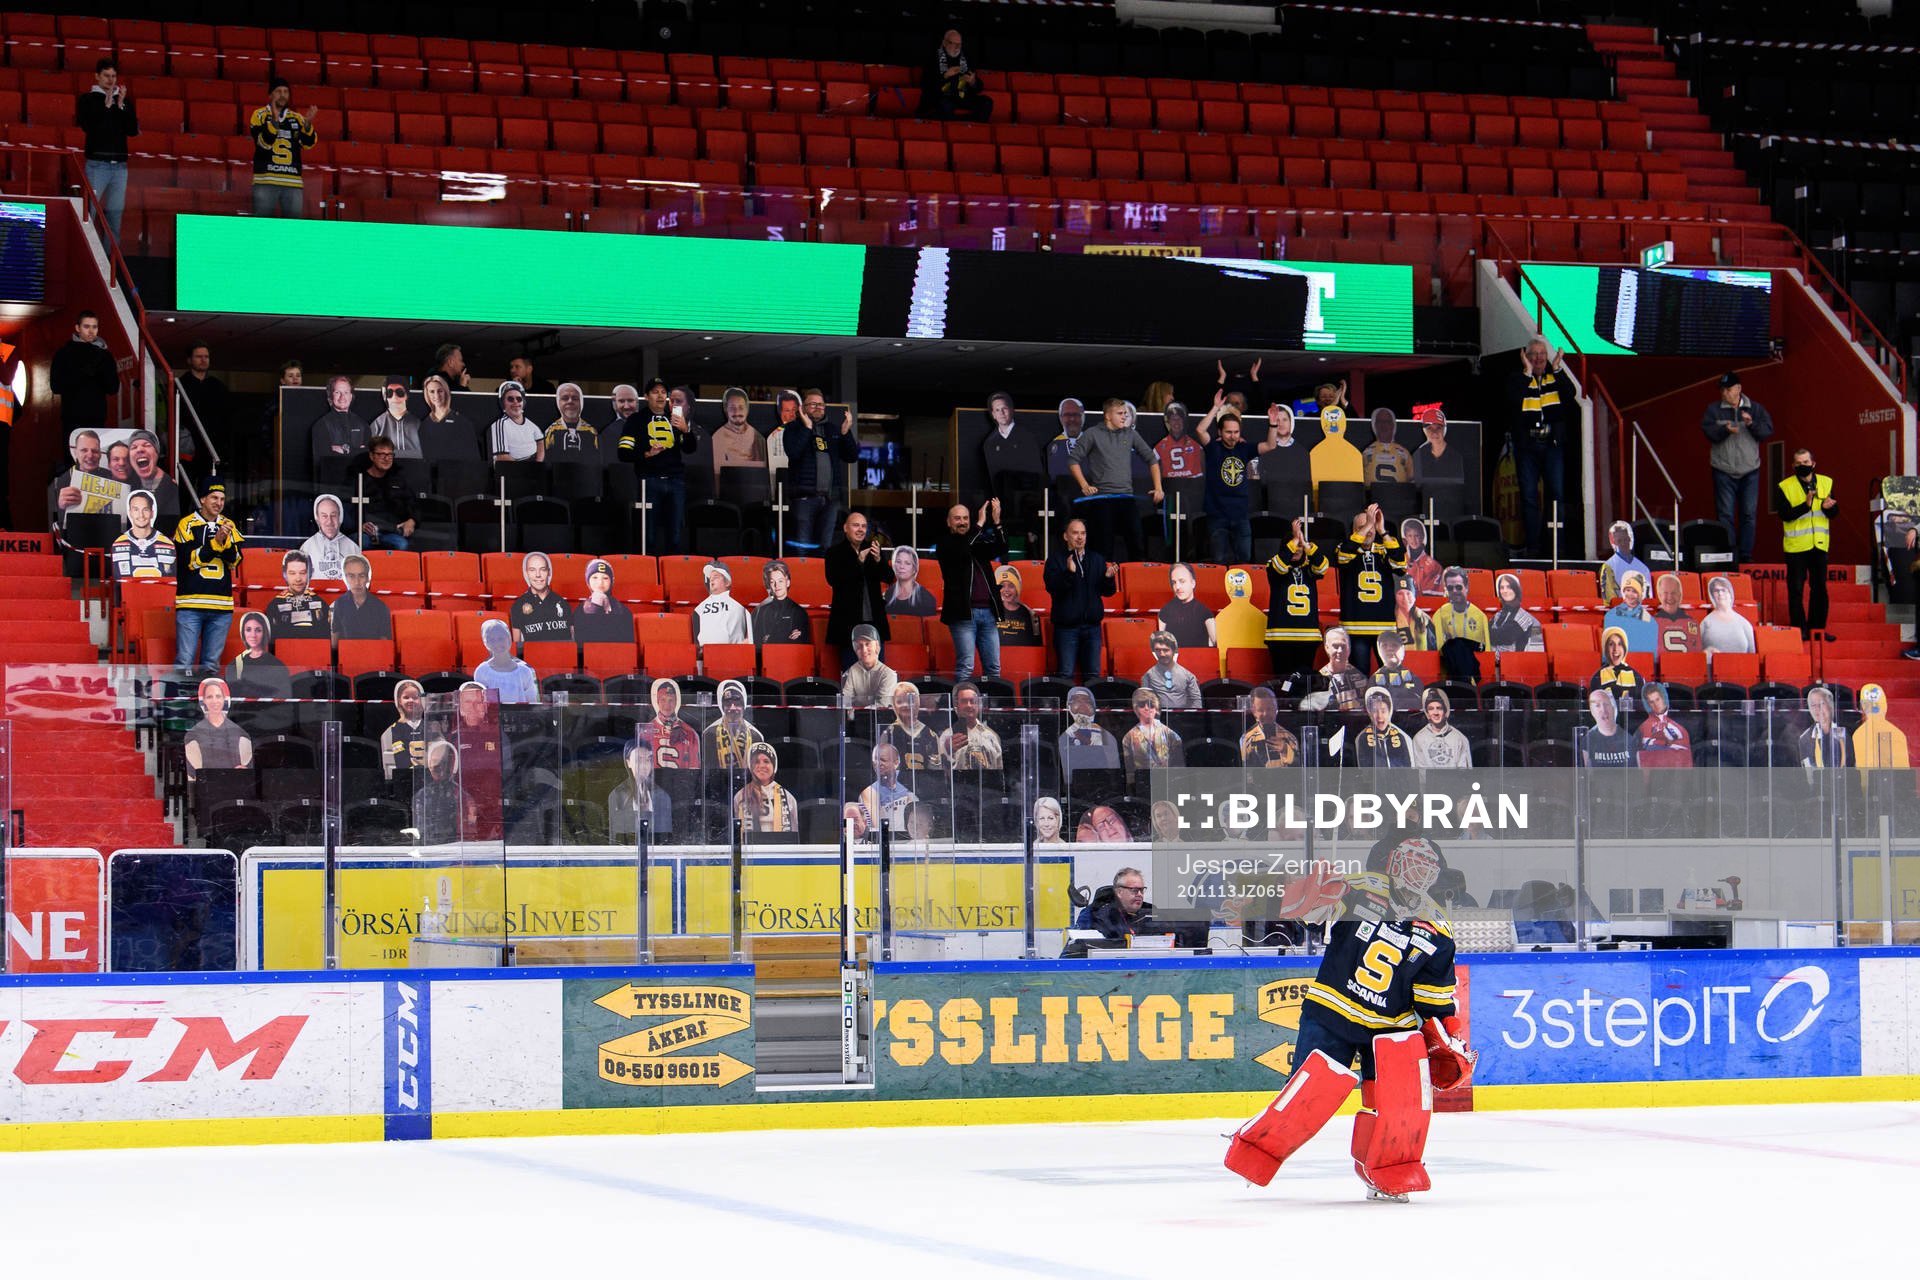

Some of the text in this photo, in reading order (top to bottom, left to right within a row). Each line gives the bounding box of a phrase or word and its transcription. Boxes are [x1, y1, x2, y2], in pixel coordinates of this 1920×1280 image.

[272, 138, 292, 166] S
[267, 164, 298, 173] SCANIA
[1859, 408, 1896, 425] VÄNSTER
[647, 420, 675, 449] S
[1170, 447, 1185, 470] S
[81, 473, 121, 499] HEJA!
[1287, 583, 1311, 616] S
[1358, 570, 1383, 603] S
[525, 620, 567, 634] NEW YORK
[1366, 734, 1376, 748] S
[1391, 734, 1401, 748] S
[1355, 939, 1403, 993] S
[634, 993, 742, 1014] TYSSLINGE
[844, 981, 853, 1029] DACO
[1347, 978, 1387, 1008] SCANIA
[648, 1020, 709, 1052] ÅKERI
[874, 994, 1234, 1067] SSLINGE
[1502, 986, 1751, 1067] 3stepIT
[0, 1015, 310, 1085] CM
[398, 981, 419, 1111] CCM
[604, 1058, 664, 1079] 08-550
